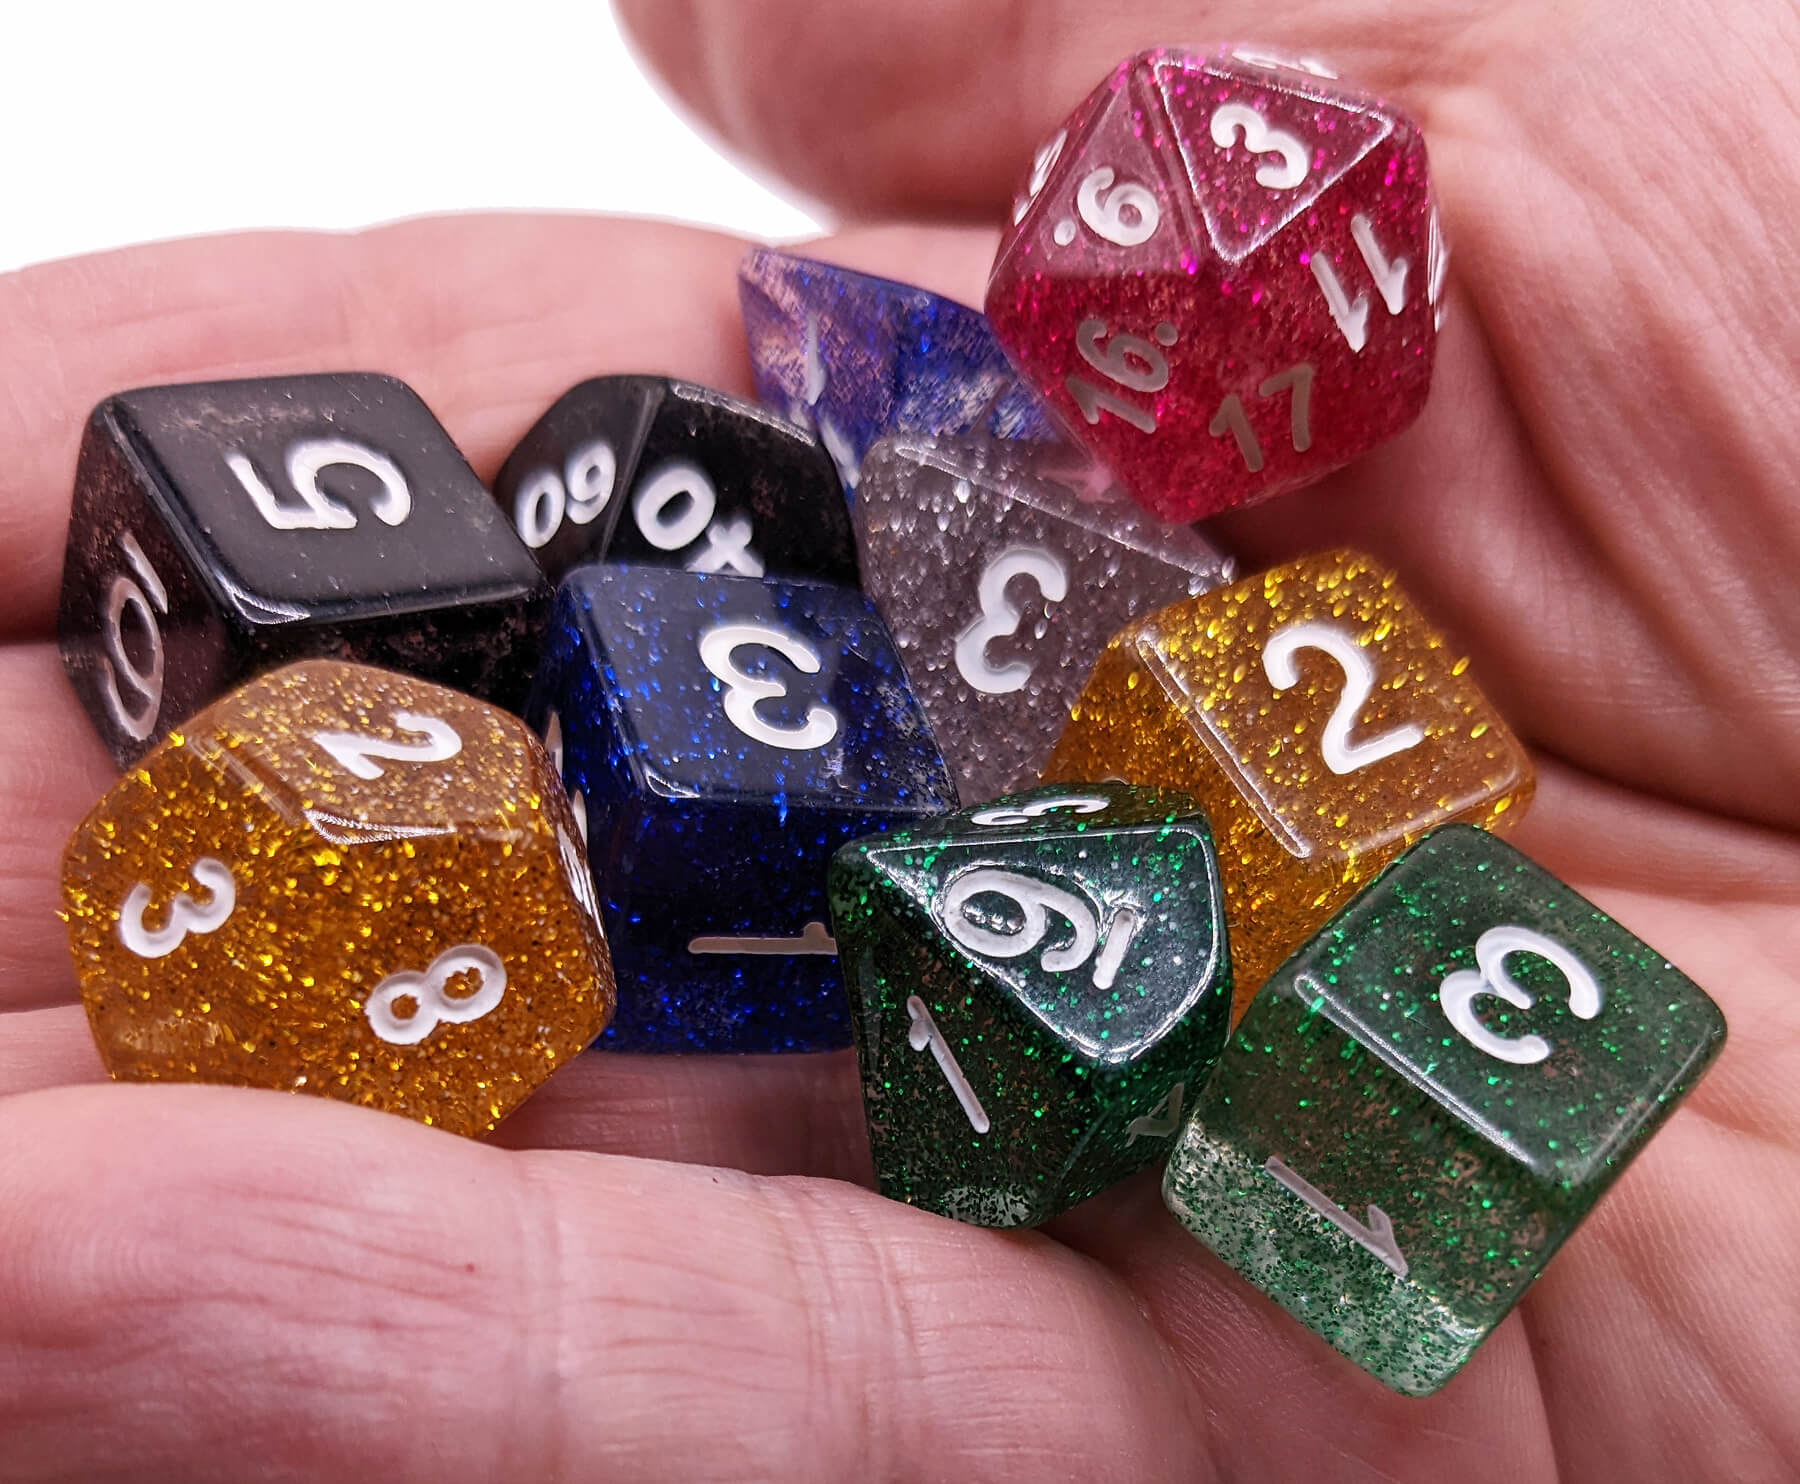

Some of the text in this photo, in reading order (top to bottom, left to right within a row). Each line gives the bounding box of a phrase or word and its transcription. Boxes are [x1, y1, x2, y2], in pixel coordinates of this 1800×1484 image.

[1210, 103, 1309, 189] 3
[1310, 214, 1409, 353] 11
[1208, 364, 1315, 472] 17
[226, 438, 412, 529] 5
[955, 548, 1067, 694] 3
[699, 624, 838, 750] 3
[1262, 623, 1424, 774] 2
[313, 713, 462, 779] 2
[120, 857, 236, 959] 3
[688, 922, 838, 956] 1
[365, 943, 507, 1045] 8
[1439, 926, 1602, 1064] 3
[907, 996, 989, 1134] 1
[1264, 1156, 1409, 1277] 1
